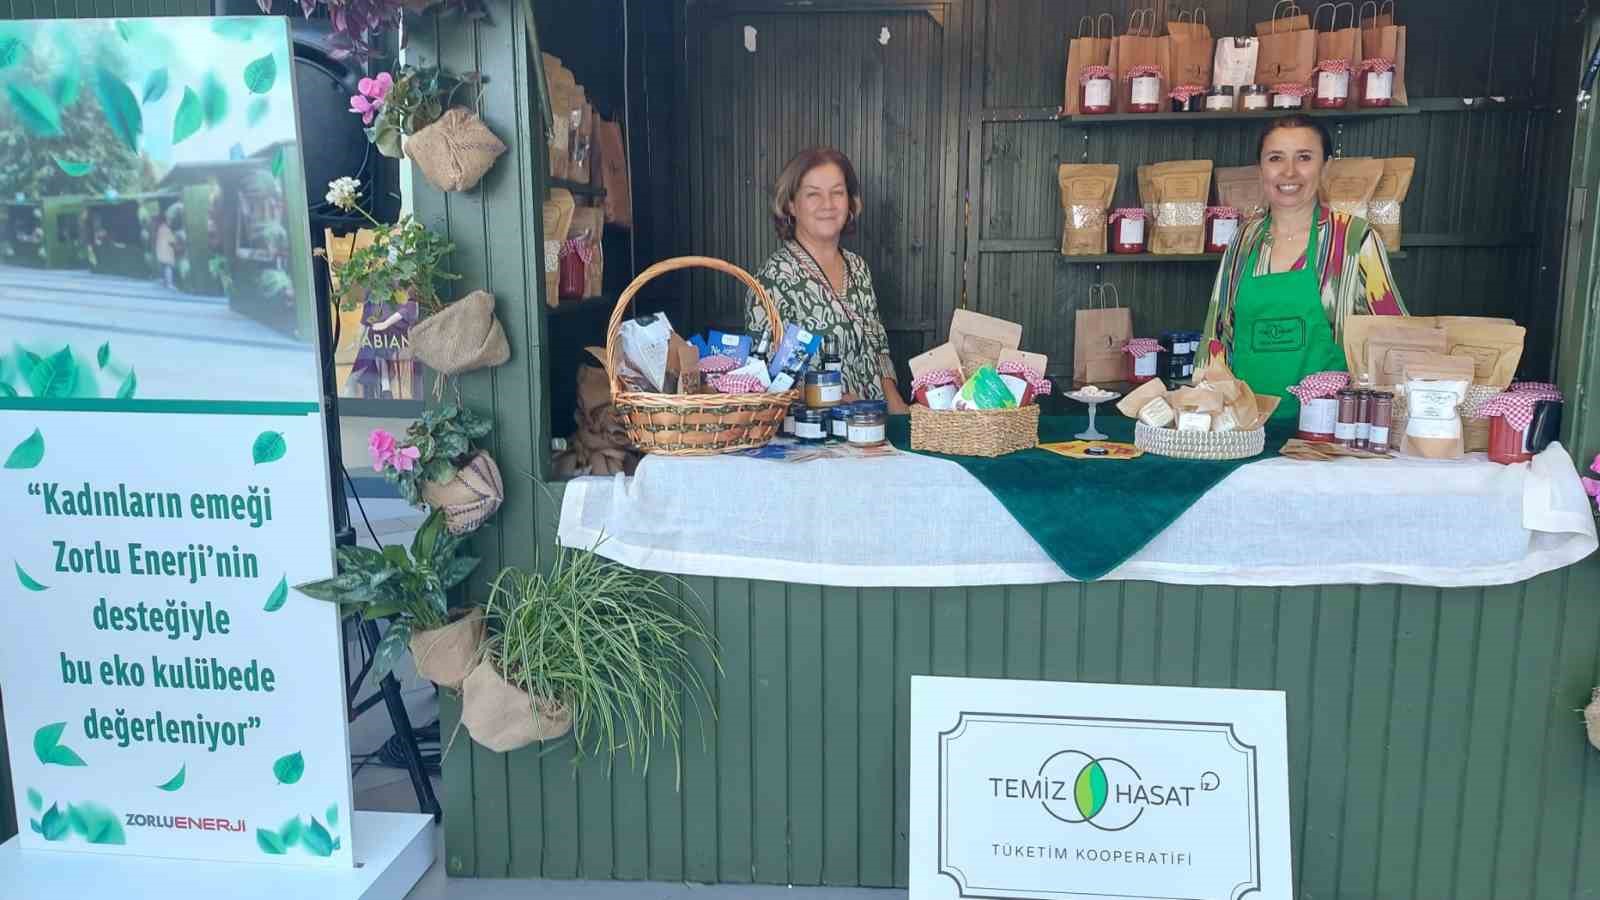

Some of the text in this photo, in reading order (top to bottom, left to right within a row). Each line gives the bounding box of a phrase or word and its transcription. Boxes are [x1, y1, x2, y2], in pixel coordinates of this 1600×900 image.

[189, 486, 274, 529] emeği
[52, 541, 121, 574] Zorlu
[92, 598, 230, 641] desteğiyle
[60, 652, 276, 693] bu eko kulübede
[988, 777, 1196, 807] TEMİZ HASAT
[991, 844, 1192, 867] TÜKETİM KOOPERATİFİ
